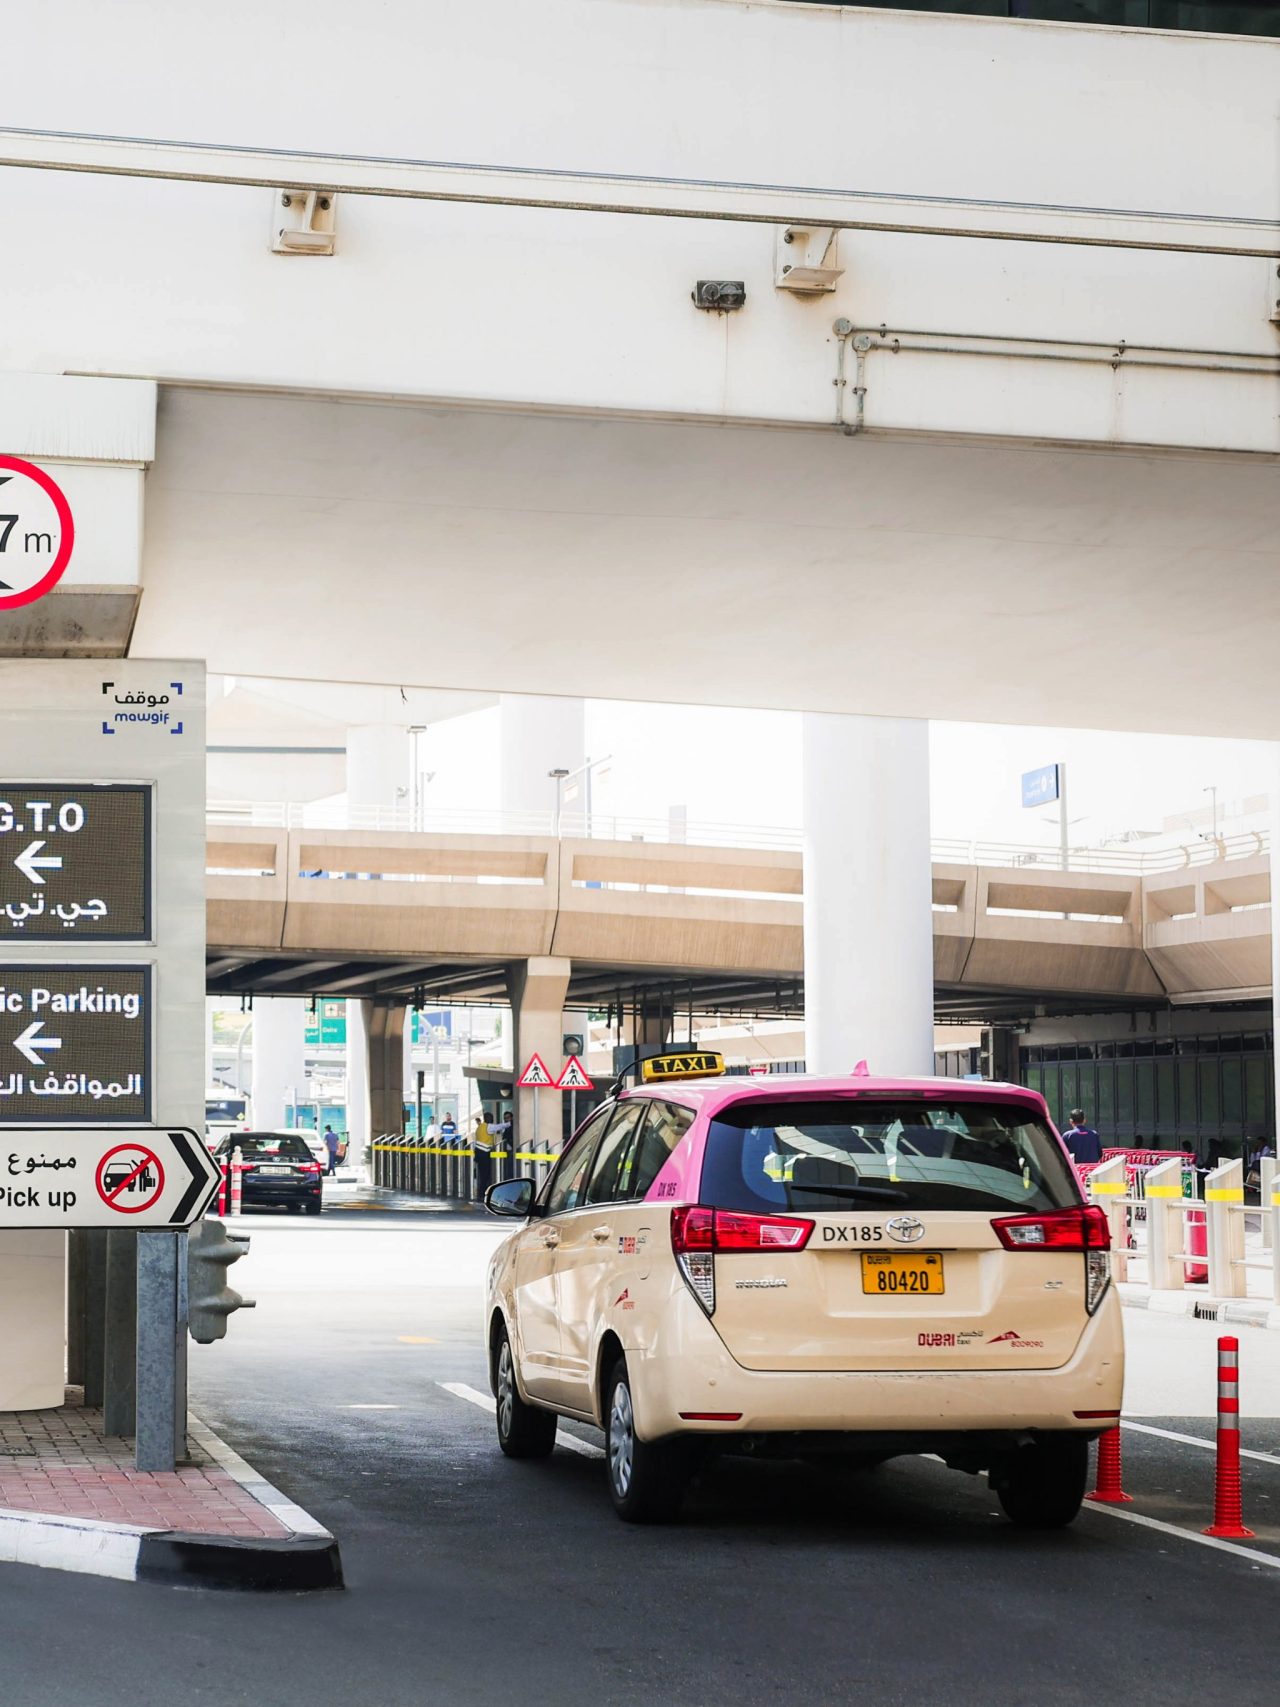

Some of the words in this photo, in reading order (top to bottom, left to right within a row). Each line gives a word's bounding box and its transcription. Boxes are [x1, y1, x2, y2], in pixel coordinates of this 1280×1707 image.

[24, 533, 52, 553] m
[115, 690, 170, 707] موقف
[31, 986, 140, 1018] Parking
[659, 1057, 707, 1073] TAXI
[30, 1071, 141, 1100] المواقف
[8, 1153, 78, 1176] ممنوع
[48, 1191, 78, 1213] up
[822, 1226, 883, 1242] DX185
[877, 1270, 929, 1291] 80420
